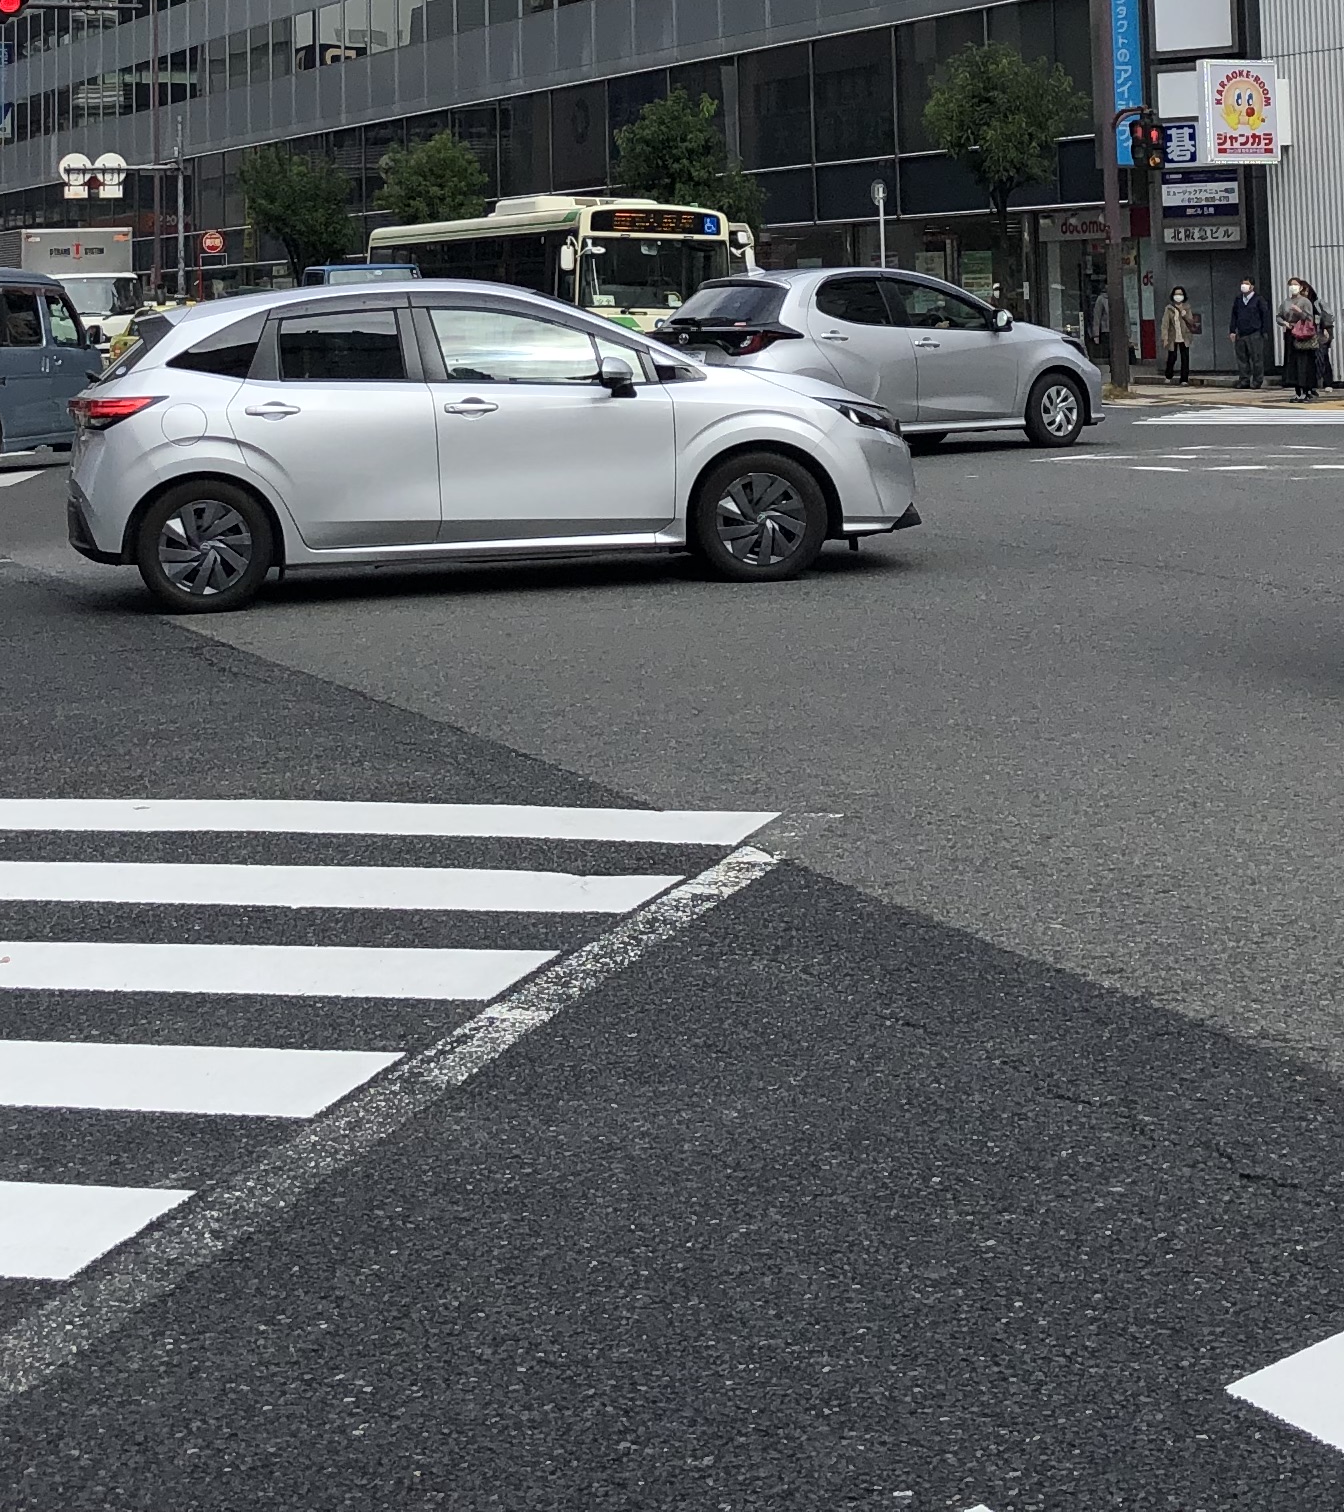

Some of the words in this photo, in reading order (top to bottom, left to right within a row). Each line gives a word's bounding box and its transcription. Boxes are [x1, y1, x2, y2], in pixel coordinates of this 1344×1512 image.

[1166, 127, 1196, 162] 碁
[1217, 132, 1274, 147] ジャンカラ
